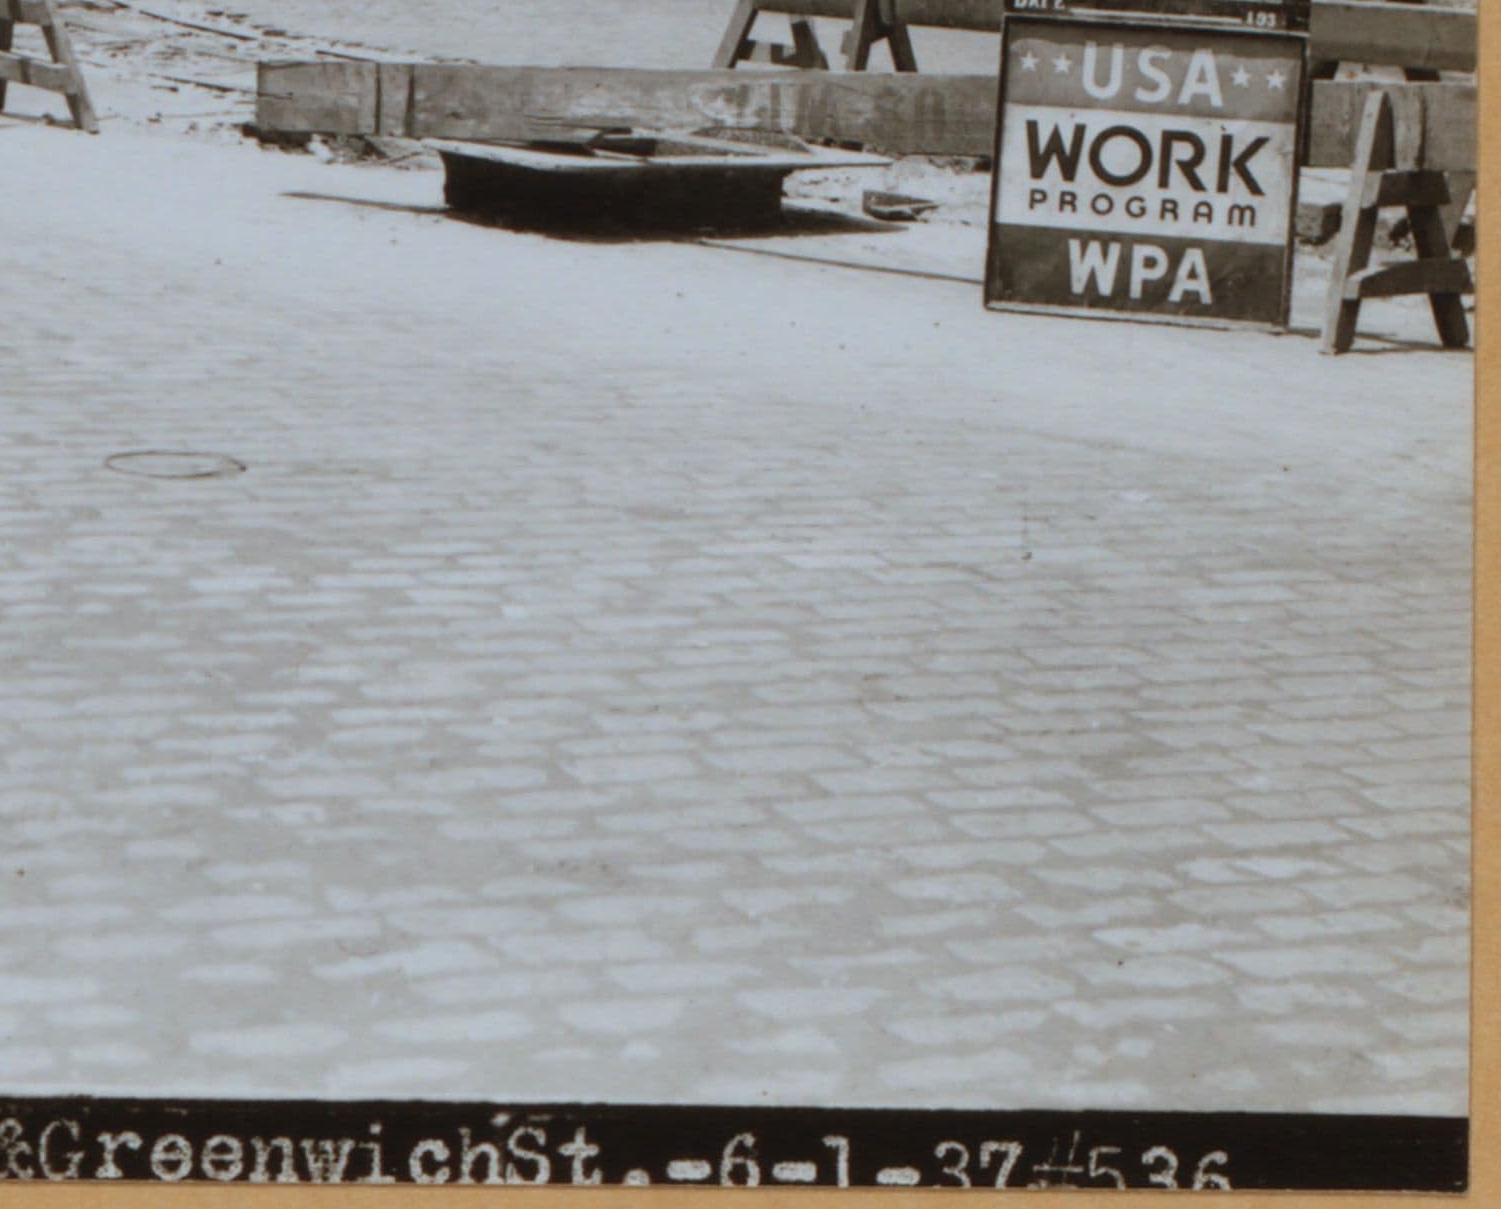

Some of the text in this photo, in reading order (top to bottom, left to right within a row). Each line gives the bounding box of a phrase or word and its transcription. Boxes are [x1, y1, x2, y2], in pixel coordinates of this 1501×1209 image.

[1080, 40, 1224, 108] USA
[1025, 119, 1272, 197] WORK
[1028, 188, 1257, 227] PROGRAM
[1067, 238, 1213, 305] WPA
